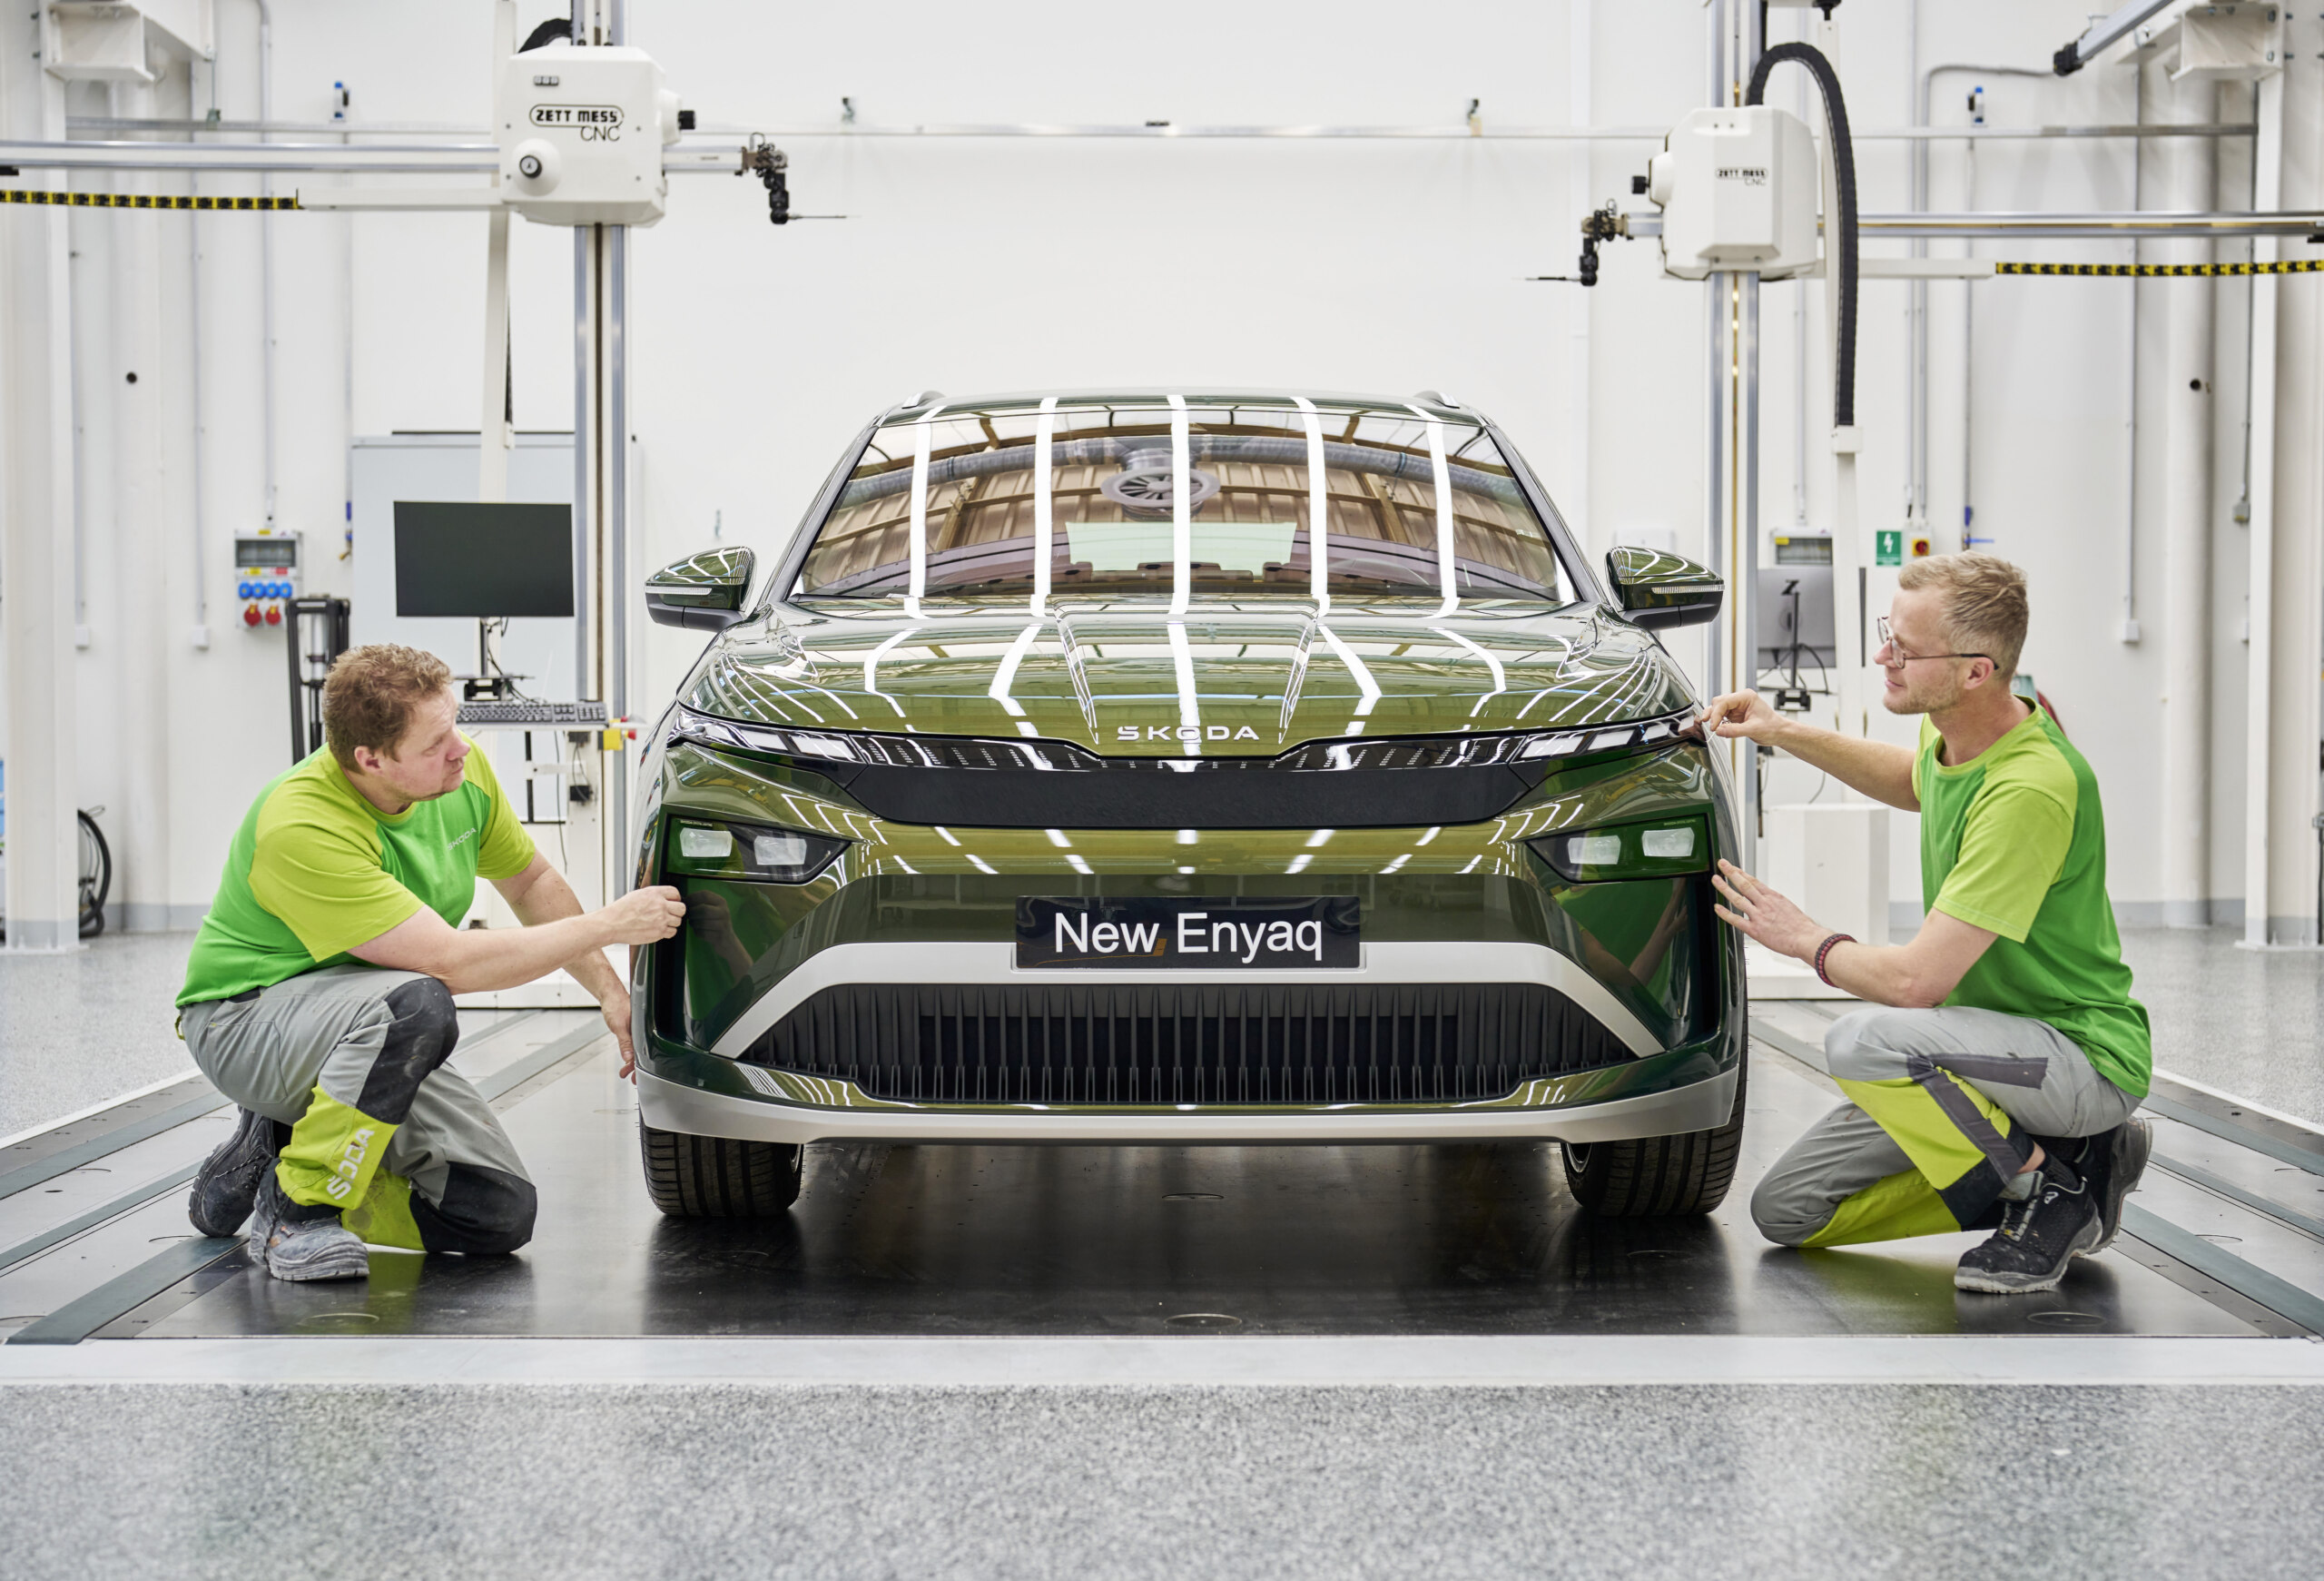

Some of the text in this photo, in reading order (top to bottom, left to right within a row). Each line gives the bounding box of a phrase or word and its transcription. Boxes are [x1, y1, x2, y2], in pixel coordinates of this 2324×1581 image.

[536, 109, 617, 123] ZETT MESS
[580, 125, 621, 142] CNC
[1055, 912, 1323, 964] New Enyaq
